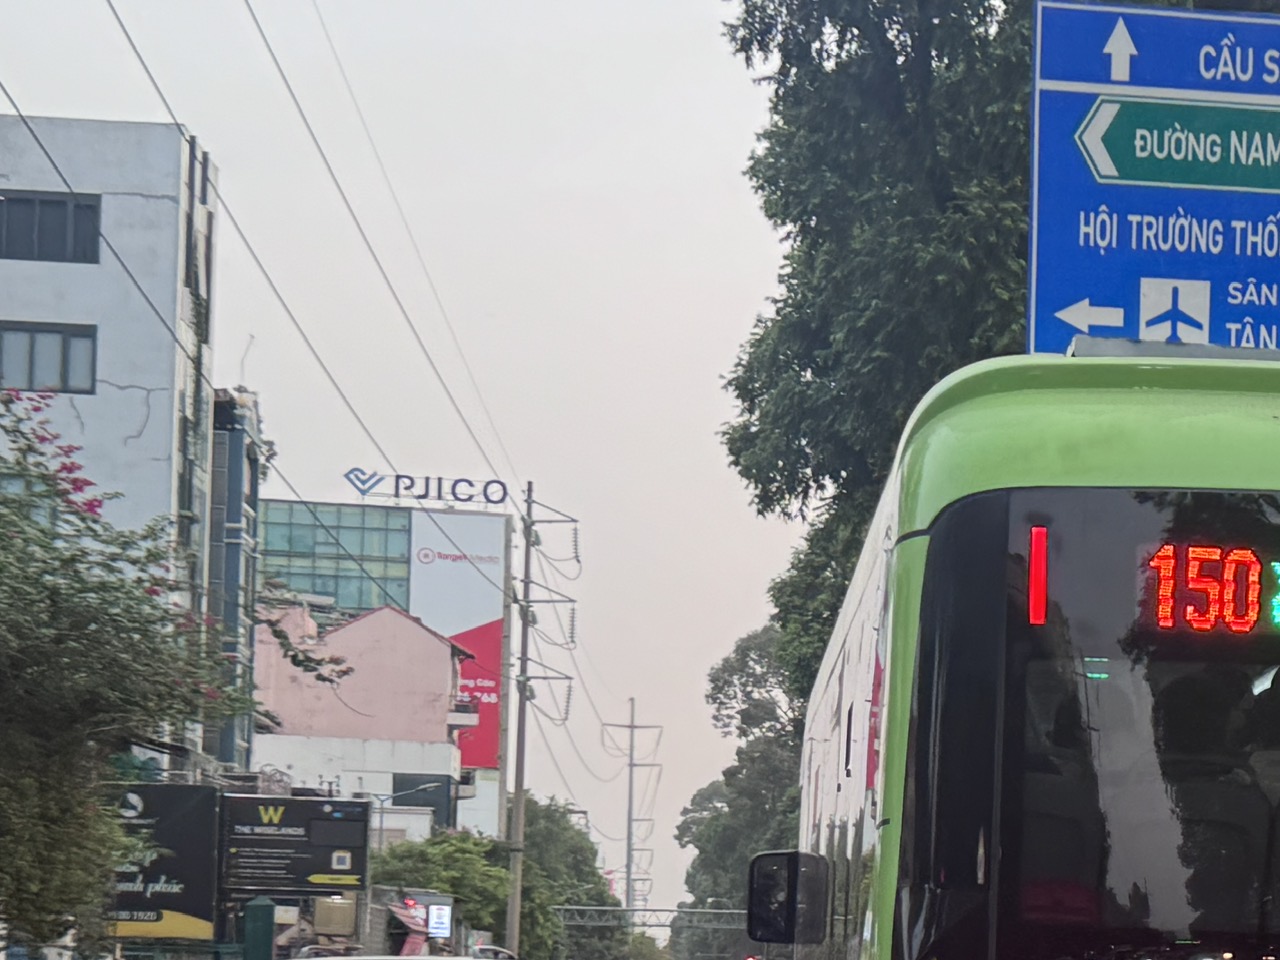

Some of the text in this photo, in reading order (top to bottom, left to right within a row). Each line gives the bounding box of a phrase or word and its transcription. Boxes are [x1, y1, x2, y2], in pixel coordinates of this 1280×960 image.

[1199, 32, 1253, 82] CẦU
[1134, 122, 1222, 163] ĐƯỜNG
[1079, 204, 1118, 256] HỘI
[1127, 206, 1224, 254] TRƯỜNG
[1227, 277, 1278, 306] SÂN
[1226, 316, 1277, 350] TÂN
[394, 474, 508, 504] PJICO
[1149, 544, 1262, 633] 150
[258, 805, 285, 824] W
